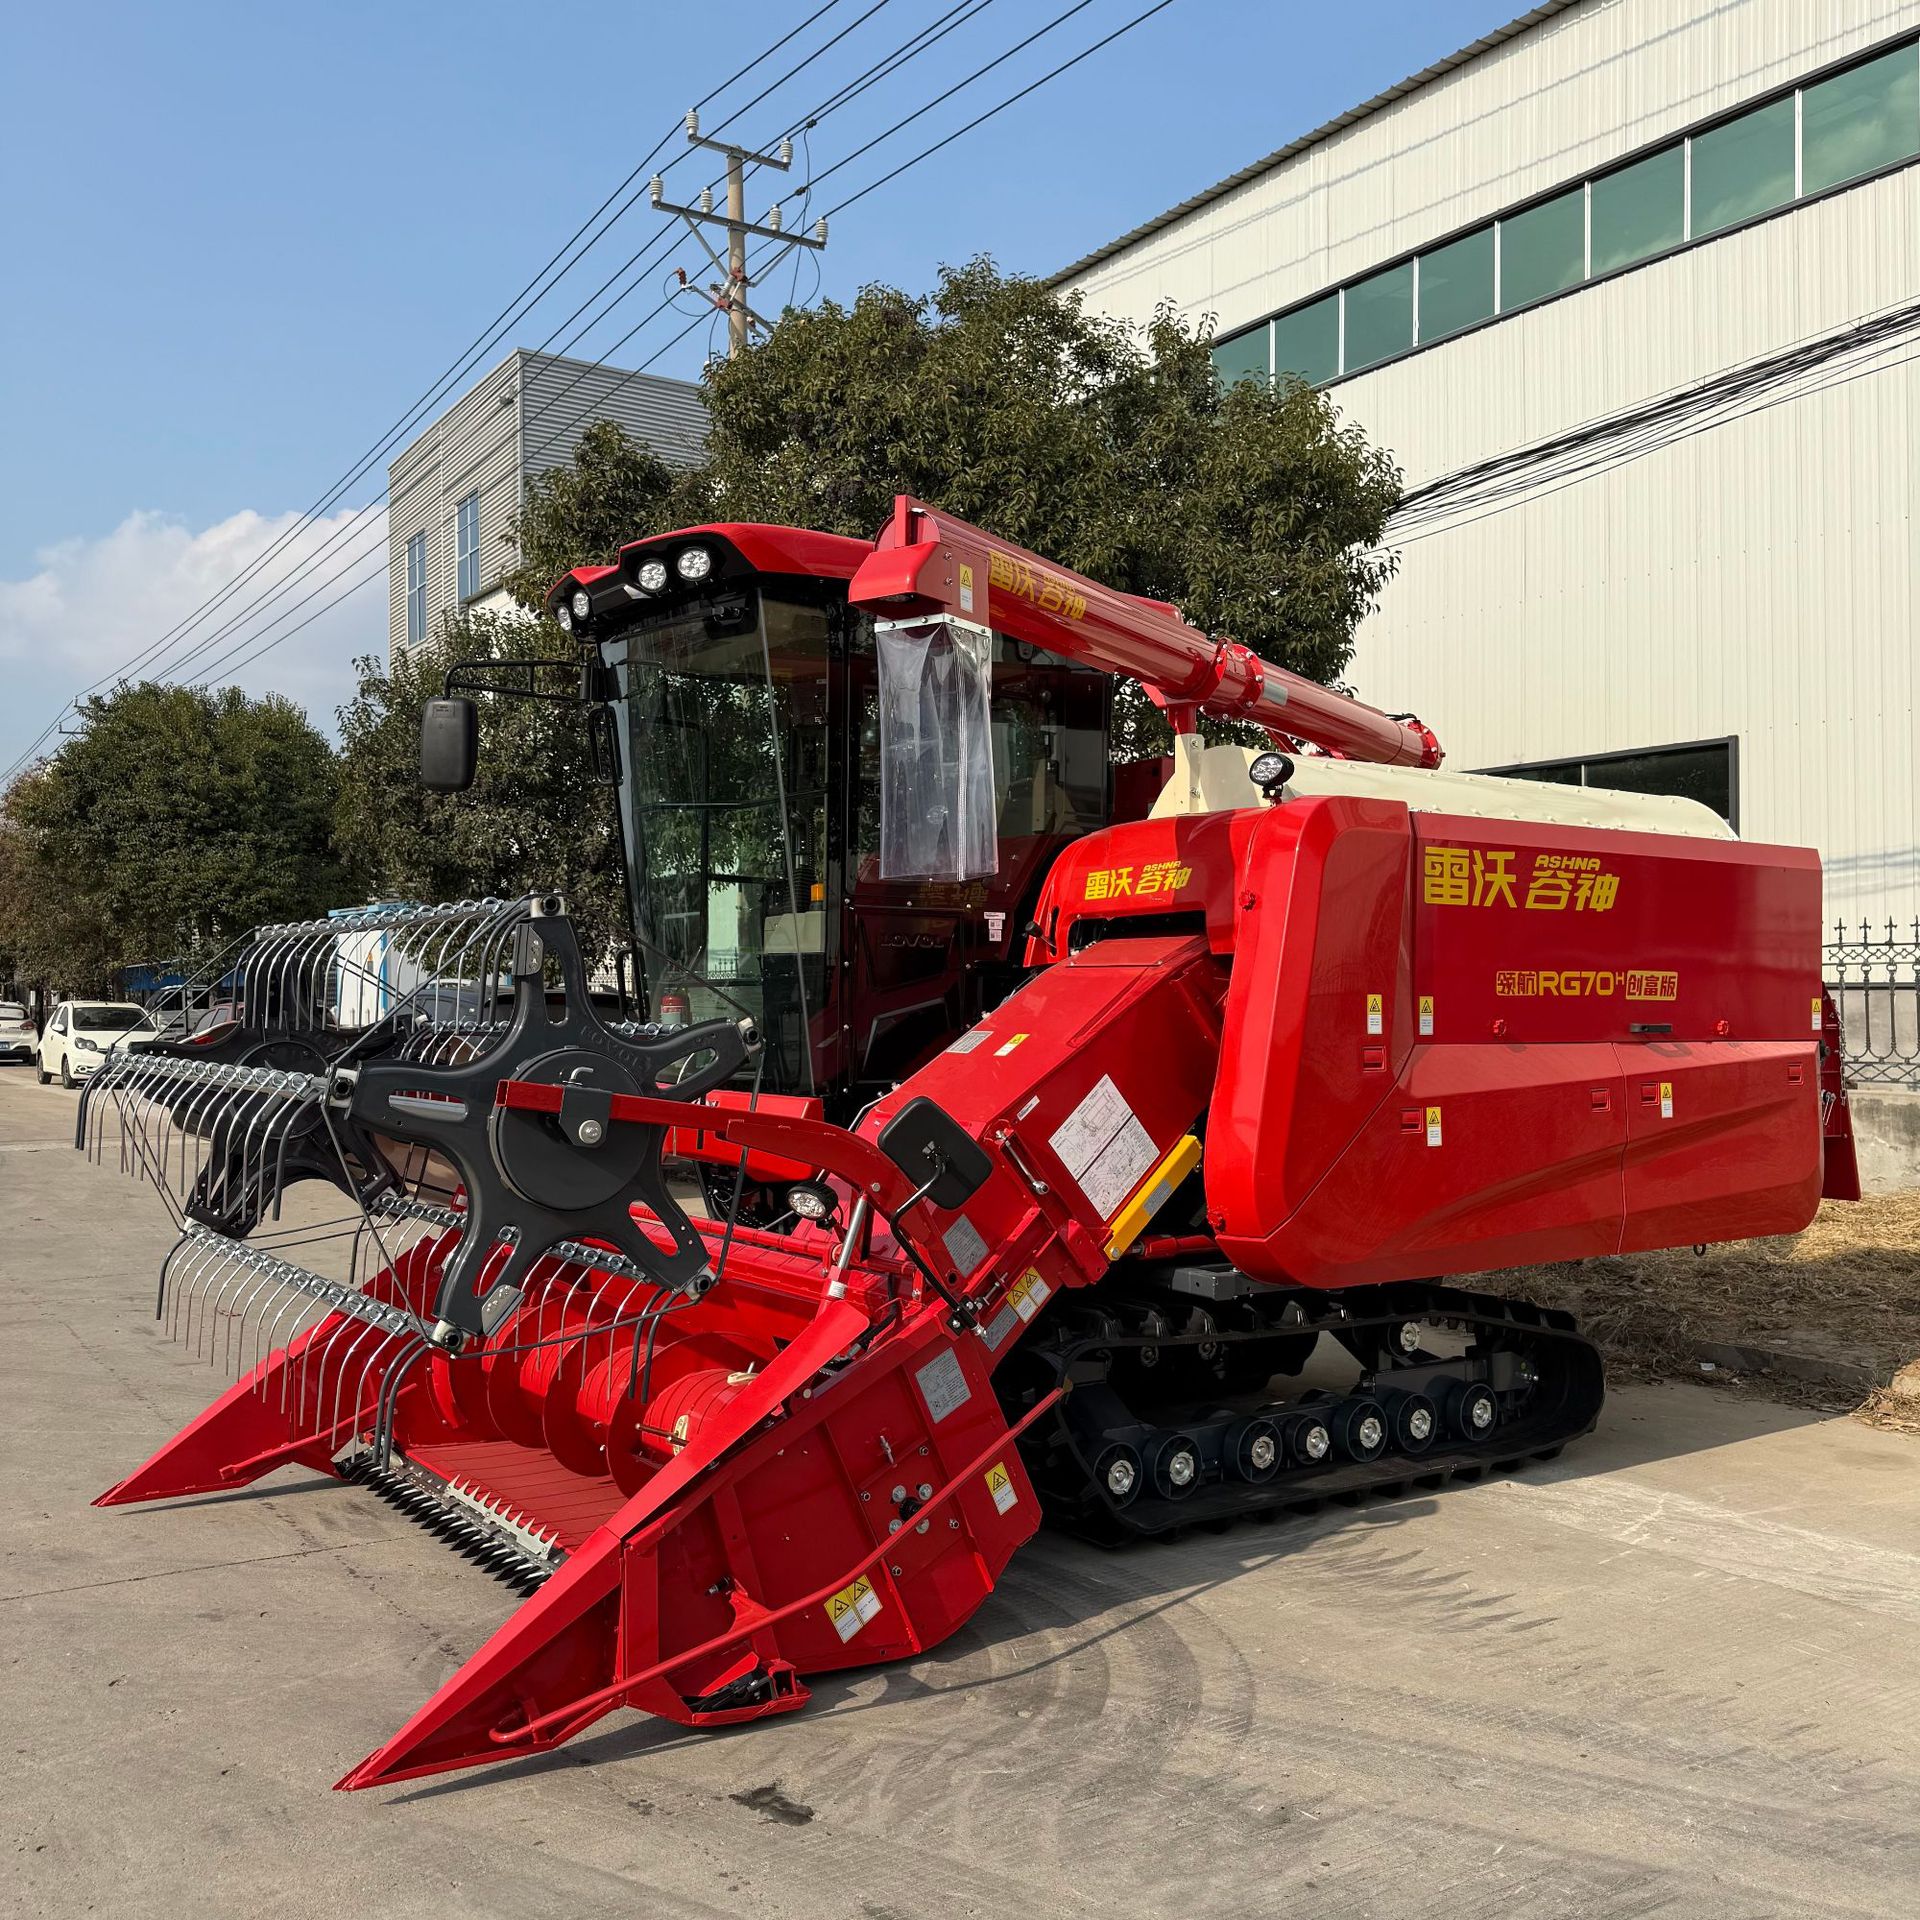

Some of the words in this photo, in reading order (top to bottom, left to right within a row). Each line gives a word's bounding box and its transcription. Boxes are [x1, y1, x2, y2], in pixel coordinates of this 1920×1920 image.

[1143, 860, 1182, 873] ASHNA
[1425, 846, 1518, 908] 雷沃
[1535, 855, 1601, 871] ASHNA
[1084, 867, 1134, 901] 雷沃
[1497, 971, 1537, 996] 领航
[1627, 971, 1677, 999] 创富版
